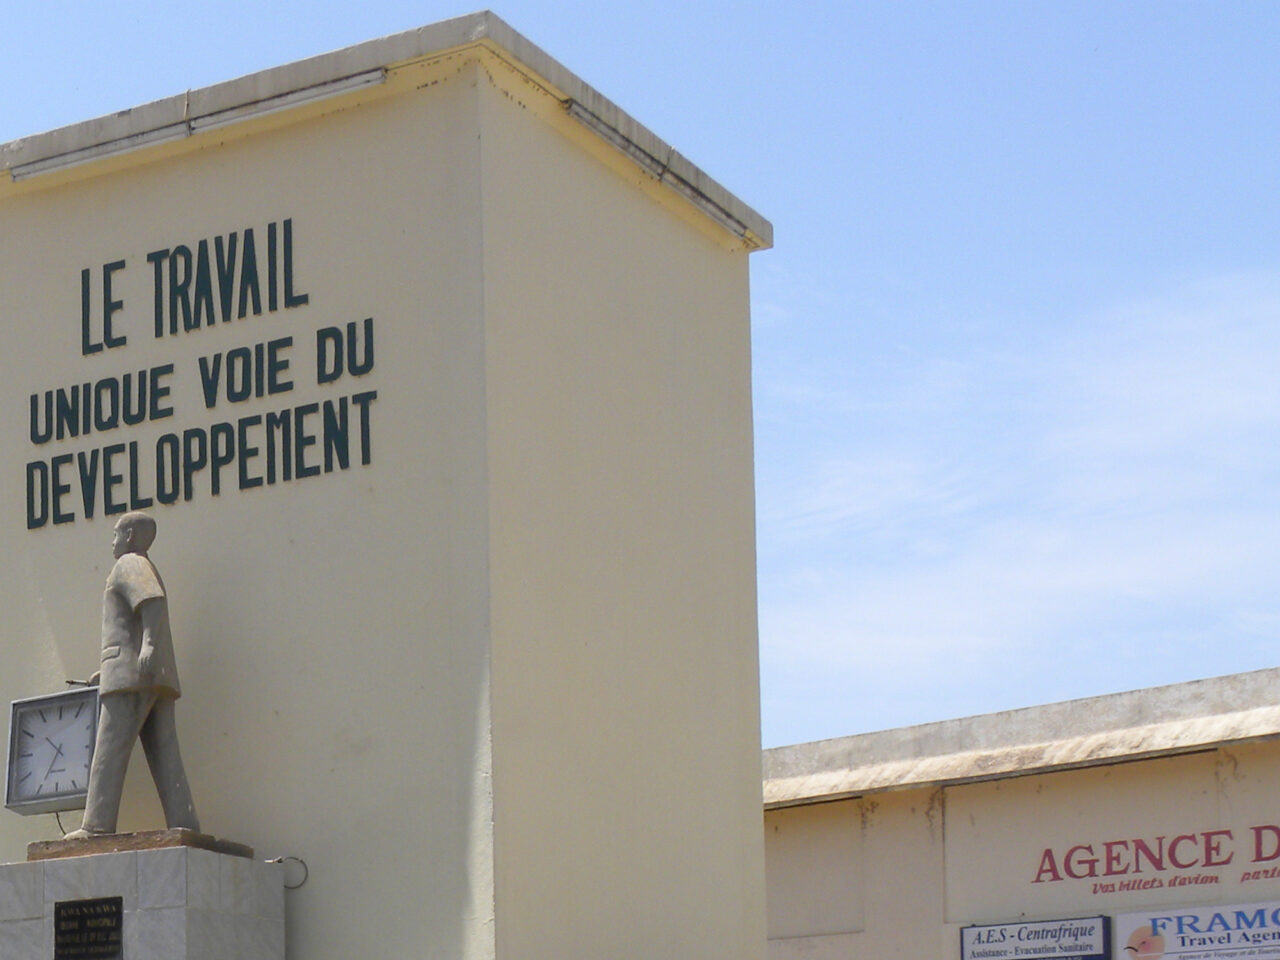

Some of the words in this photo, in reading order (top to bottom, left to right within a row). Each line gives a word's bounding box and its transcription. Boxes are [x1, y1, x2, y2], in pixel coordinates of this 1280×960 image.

[81, 259, 127, 356] LE
[147, 218, 309, 338] TRAVAIL
[30, 363, 174, 445] UNIQUE
[199, 336, 294, 409] VOIE
[317, 318, 374, 385] DU
[26, 390, 377, 530] DEVELOPPEMENT
[1031, 830, 1234, 883] AGENCE
[1092, 883, 1115, 895] Vos
[1119, 877, 1164, 892] billets
[1168, 873, 1219, 888] d'avion
[970, 948, 1008, 959] Assistance
[1014, 943, 1057, 956] Evacuation
[1058, 941, 1094, 953] Sanitaire
[972, 928, 1007, 945] A.E.S
[1017, 922, 1095, 942] Centrafrique
[1177, 932, 1232, 947] Travel
